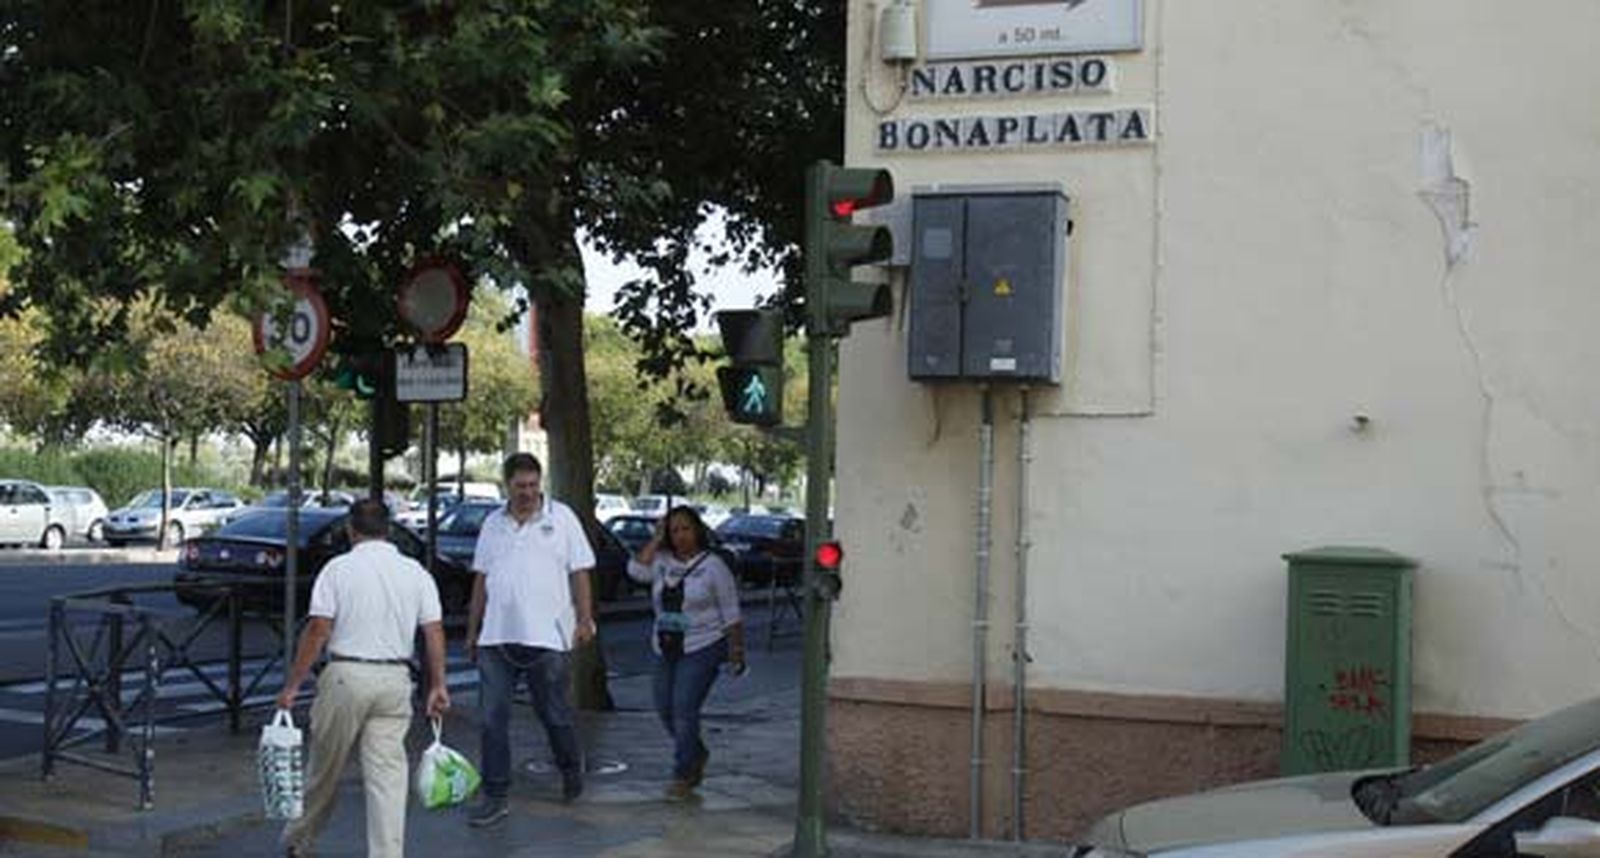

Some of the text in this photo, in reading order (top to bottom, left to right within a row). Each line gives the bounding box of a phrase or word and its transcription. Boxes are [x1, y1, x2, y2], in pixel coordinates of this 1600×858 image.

[1013, 27, 1036, 43] 50
[911, 59, 1107, 96] NARCISO
[879, 111, 1147, 150] BONAPLATA
